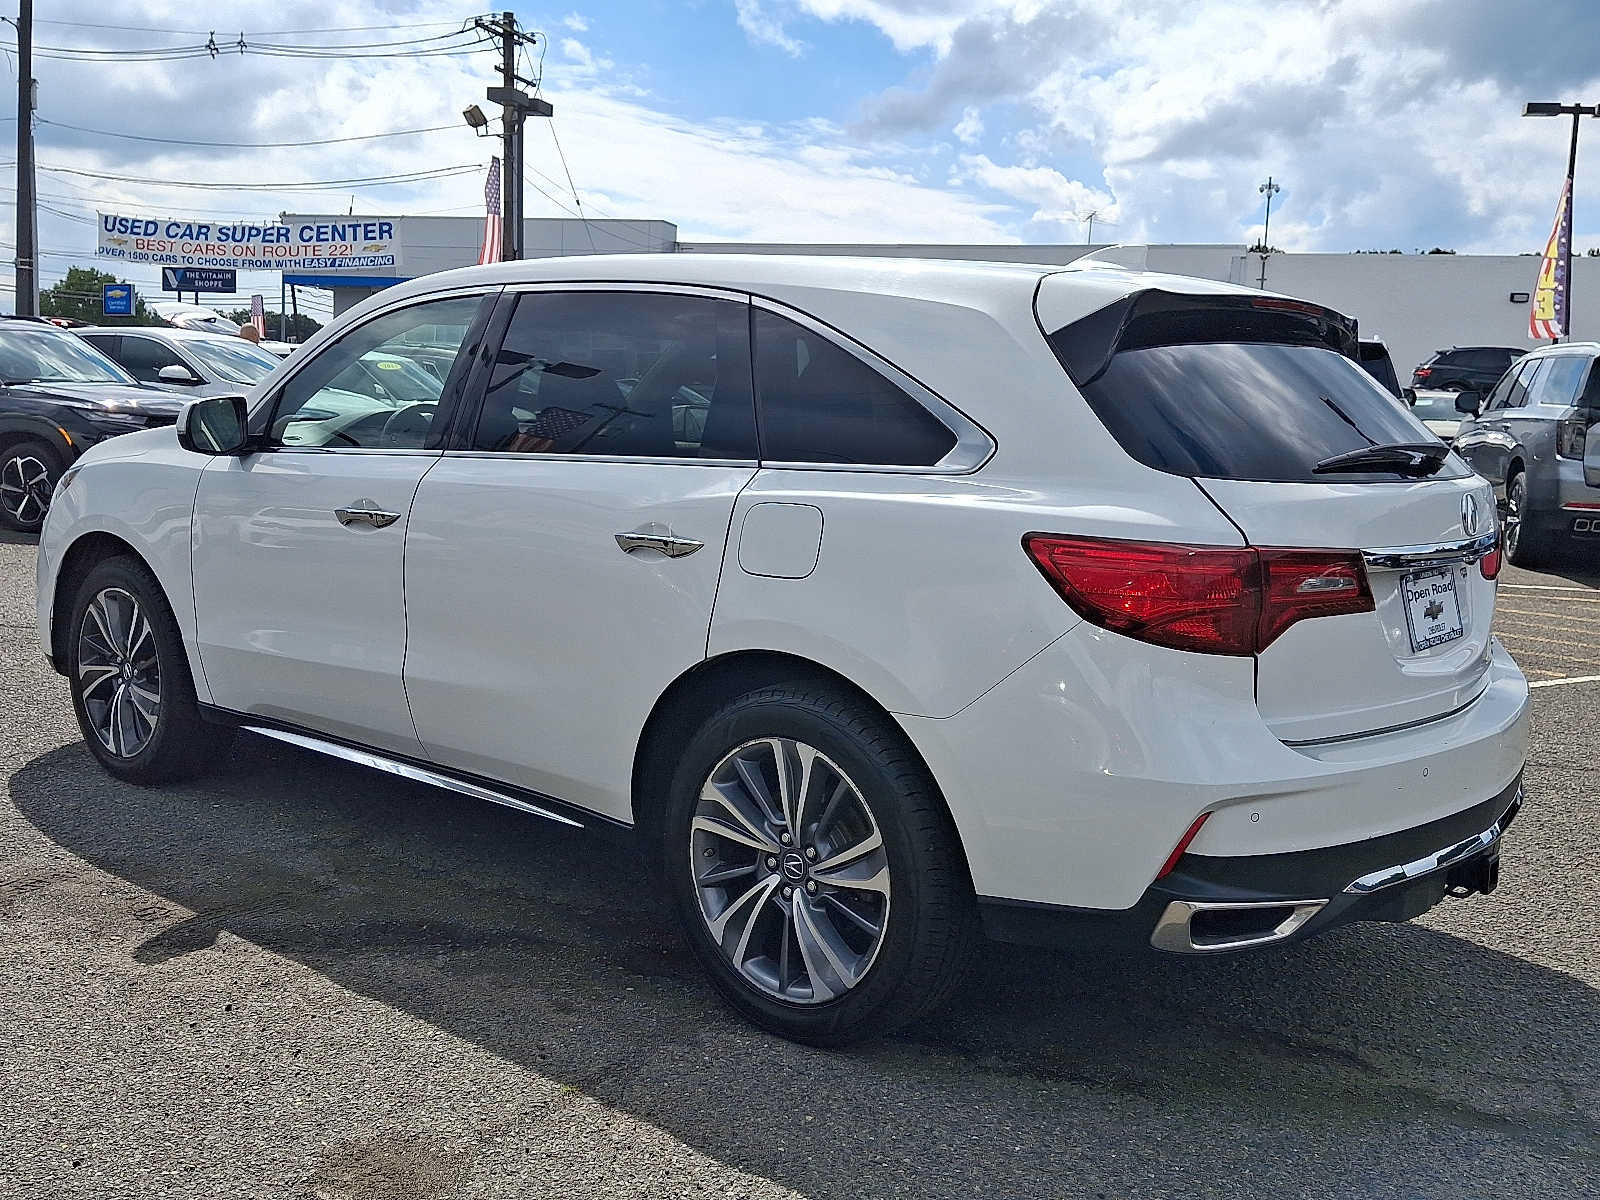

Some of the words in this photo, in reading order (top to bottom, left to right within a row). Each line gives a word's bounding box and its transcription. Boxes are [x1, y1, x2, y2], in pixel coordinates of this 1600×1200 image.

[104, 215, 159, 237] USED
[165, 222, 211, 241] CAR
[216, 225, 291, 243] SUPER
[299, 222, 393, 242] CENTER
[98, 246, 125, 257] OVER
[152, 253, 178, 263] CARS
[180, 255, 194, 265] TO
[197, 256, 239, 267] CHOOSE
[242, 258, 272, 268] FROM
[274, 259, 300, 268] WITH
[304, 258, 335, 267] EASY
[335, 255, 393, 266] FINANCING
[135, 238, 176, 253] BEST
[181, 242, 227, 256] CARS
[232, 245, 256, 257] ON
[263, 245, 322, 257] ROUTE
[328, 244, 353, 256] 22!
[186, 271, 200, 279] THE
[201, 271, 232, 280] VITAMIN
[194, 280, 223, 288] SHOPPE
[1406, 588, 1430, 603] Open
[1431, 581, 1453, 596] Road
